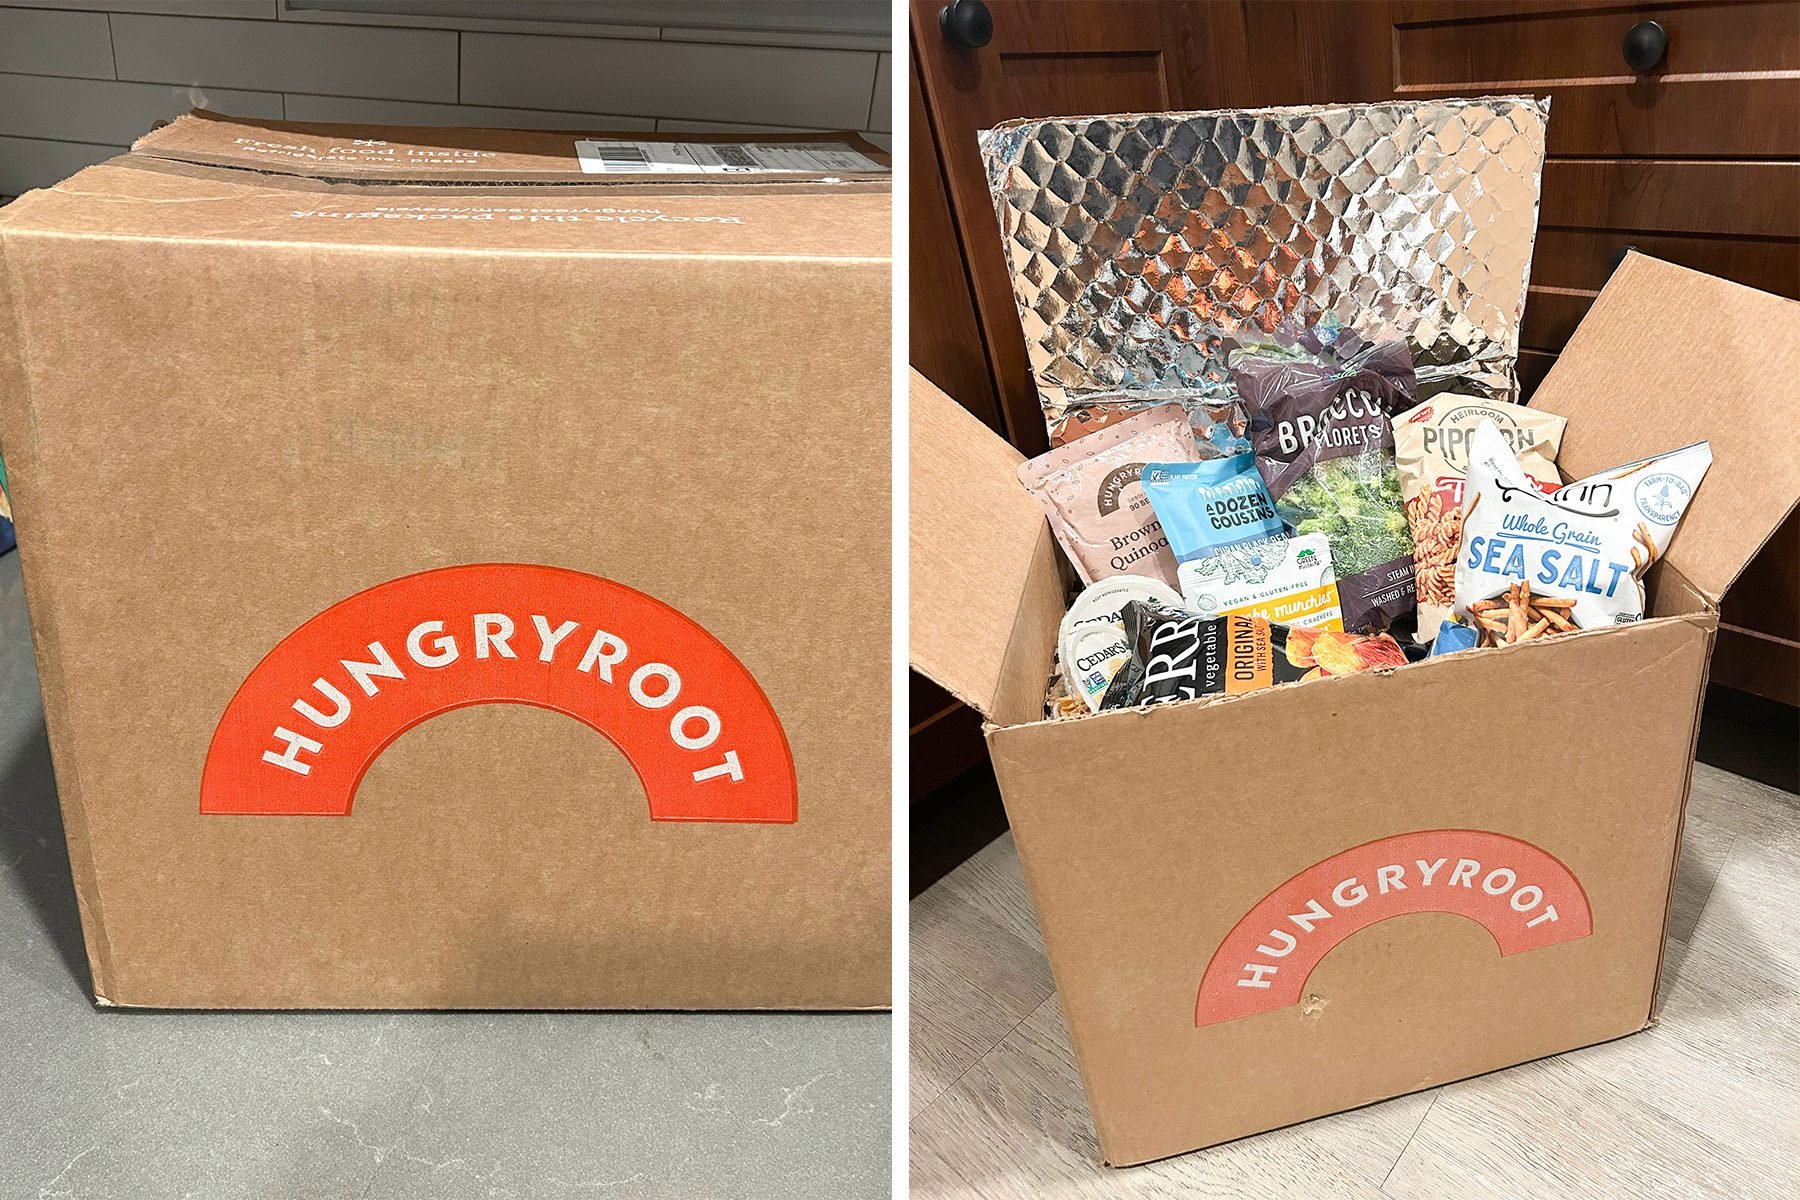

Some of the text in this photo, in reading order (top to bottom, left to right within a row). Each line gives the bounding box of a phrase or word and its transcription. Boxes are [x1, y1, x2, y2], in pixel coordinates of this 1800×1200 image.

[233, 138, 316, 154] Fresh
[328, 146, 396, 155] food
[508, 214, 582, 223] this
[593, 213, 745, 226] Recycle
[1450, 409, 1505, 424] HEIRLOOM
[1423, 427, 1535, 461] PIPCRN
[1104, 467, 1142, 507] HUNGRYR
[1129, 498, 1150, 511] 90 SE
[1206, 492, 1268, 516] A DOZEN
[1211, 506, 1275, 530] COUSINS
[1502, 514, 1602, 546] Whole Grain
[1110, 520, 1162, 551] Brown
[1110, 537, 1169, 572] Quinoa
[1297, 555, 1318, 565] GREEN
[1386, 566, 1409, 581] STEAM
[1467, 536, 1629, 598] SEA SALT
[1223, 595, 1249, 607] VEGAN
[1260, 581, 1309, 598] GLUTEN-FREE
[1371, 589, 1400, 607] WASHED
[1406, 583, 1415, 595] RE
[1303, 611, 1333, 625] CRACKERS
[1203, 624, 1220, 688] vegetable
[1256, 636, 1267, 652] SEA
[1076, 642, 1127, 672] CEDAR'S
[1256, 653, 1267, 672] WITH
[260, 612, 745, 783] HUNGRYROOT
[1236, 857, 1560, 989] HUNGRYROOT
